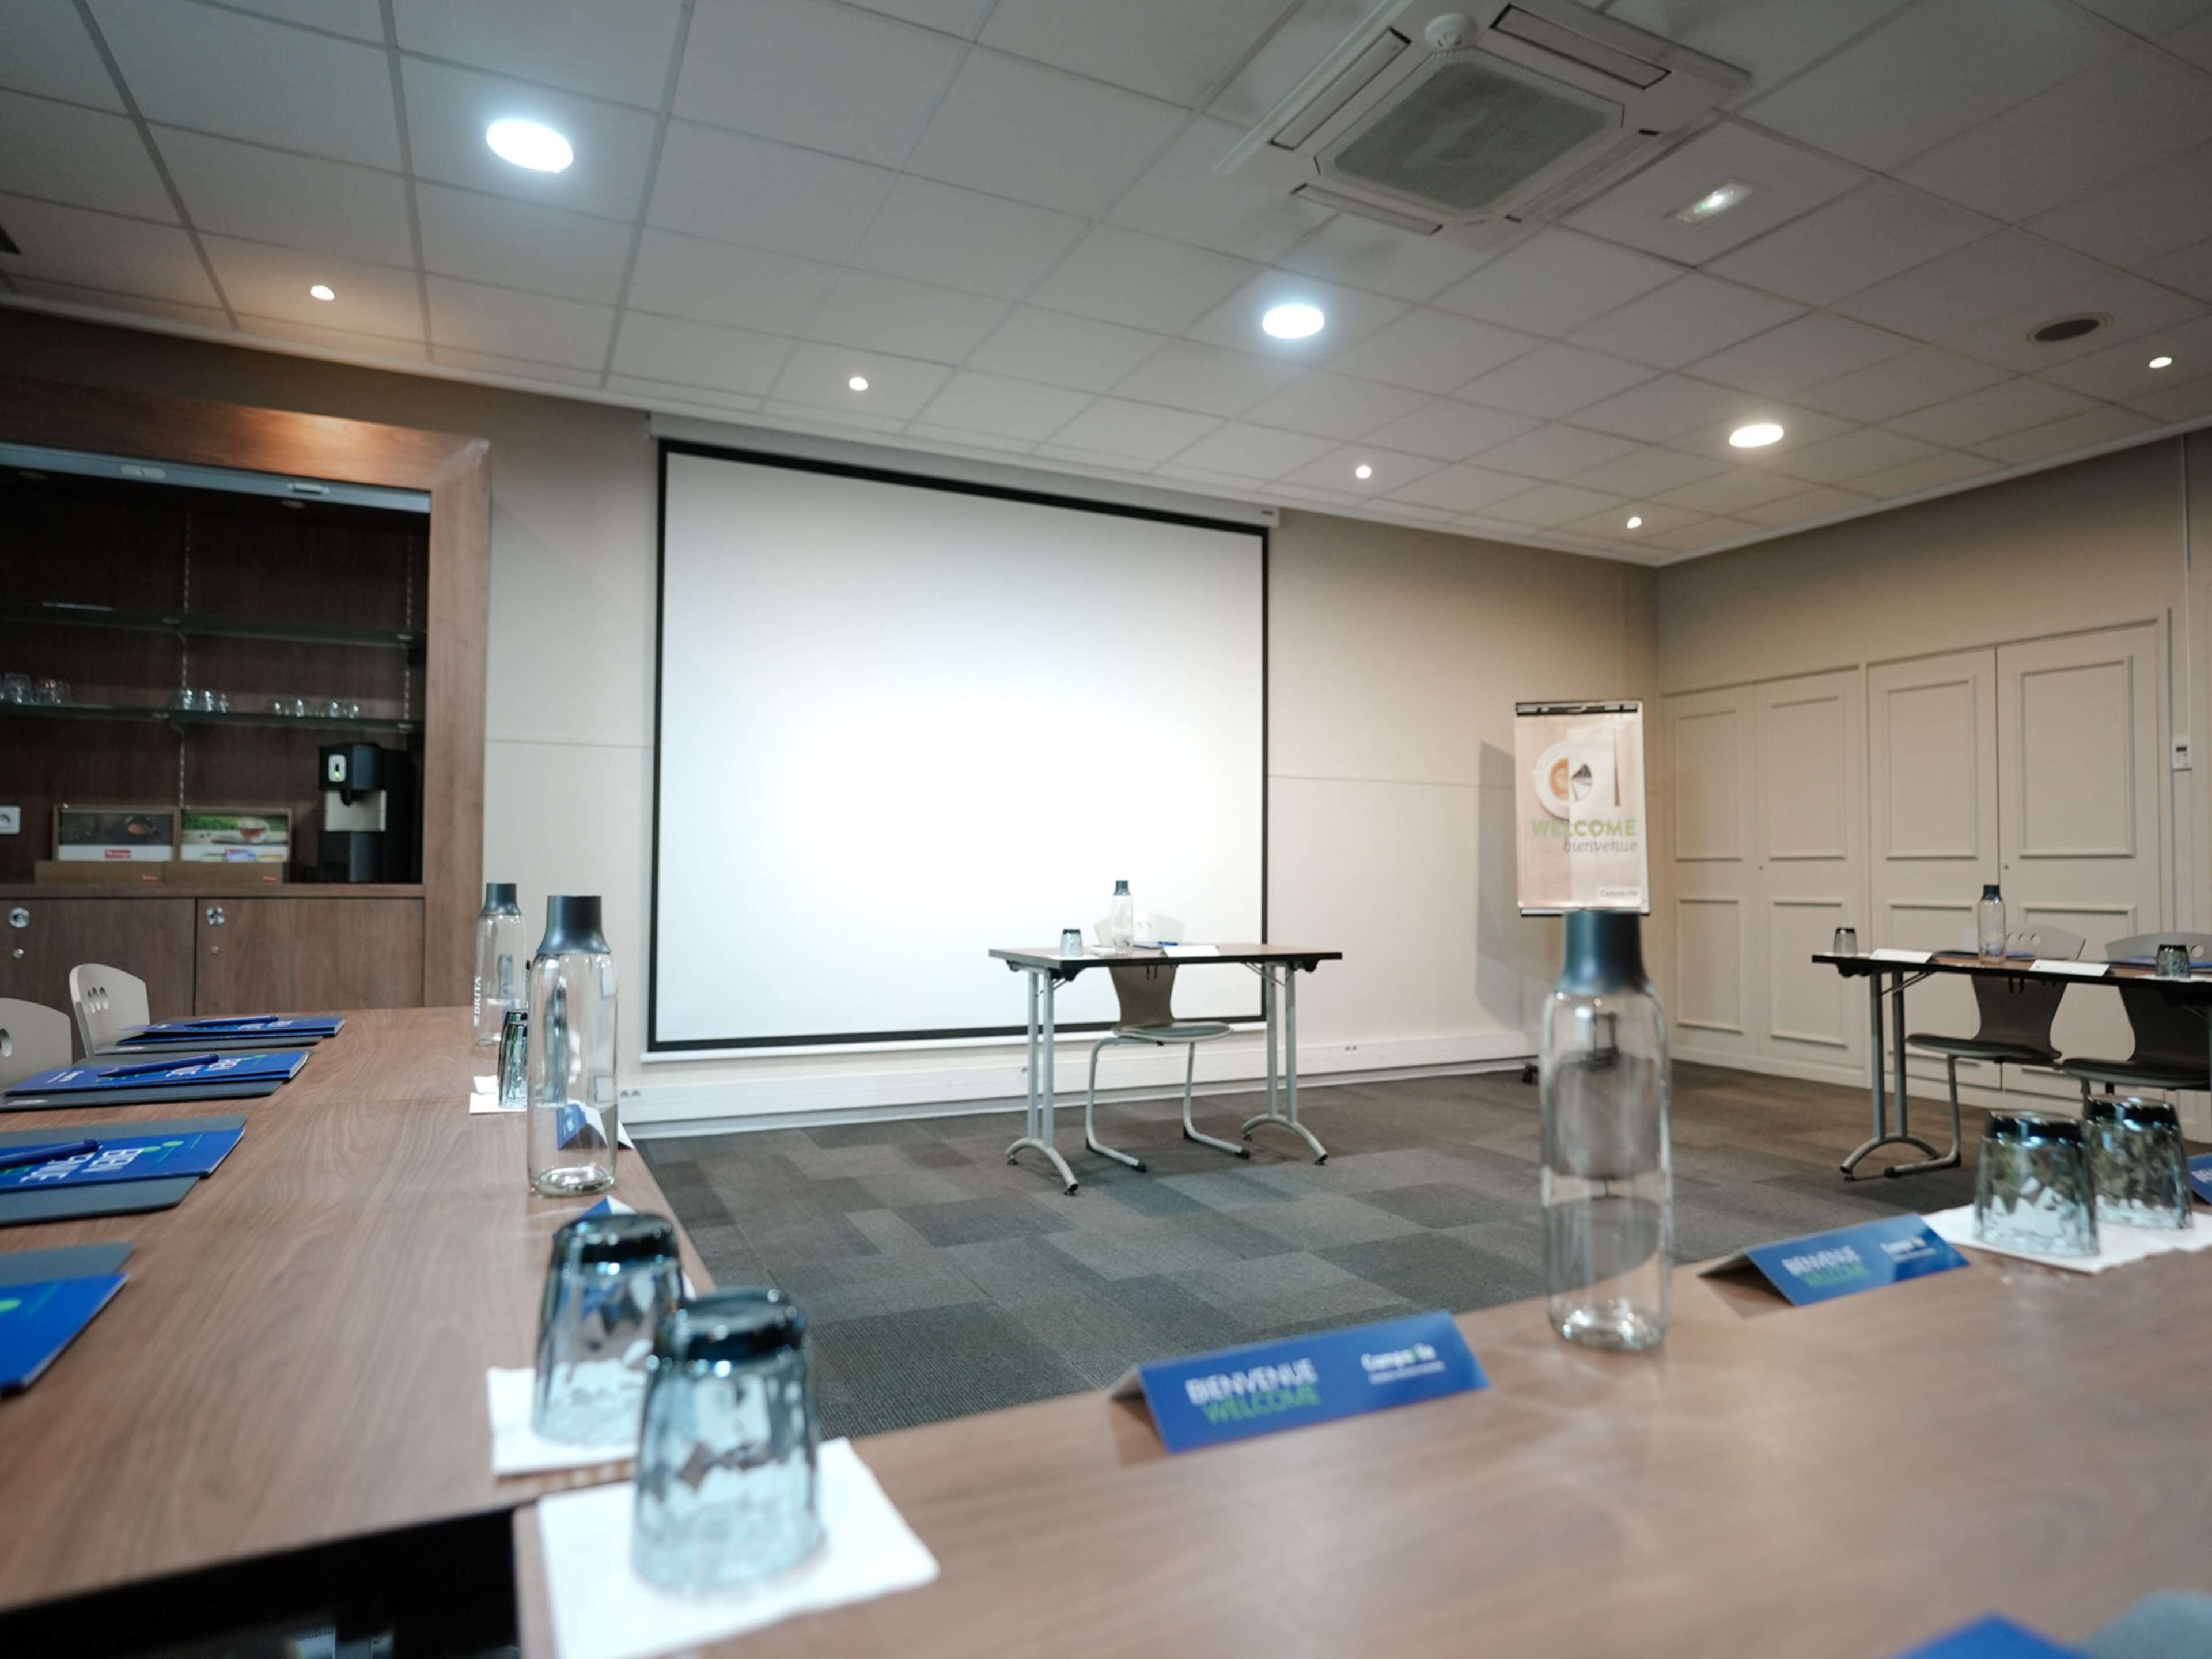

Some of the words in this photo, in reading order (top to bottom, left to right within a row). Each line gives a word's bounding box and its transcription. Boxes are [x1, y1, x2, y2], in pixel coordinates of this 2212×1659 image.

[1531, 819, 1637, 837] WELCOME
[1563, 838, 1638, 853] bienvenue
[1185, 1358, 1319, 1406] BIENVENUE
[1202, 1382, 1321, 1424] WELCOME
